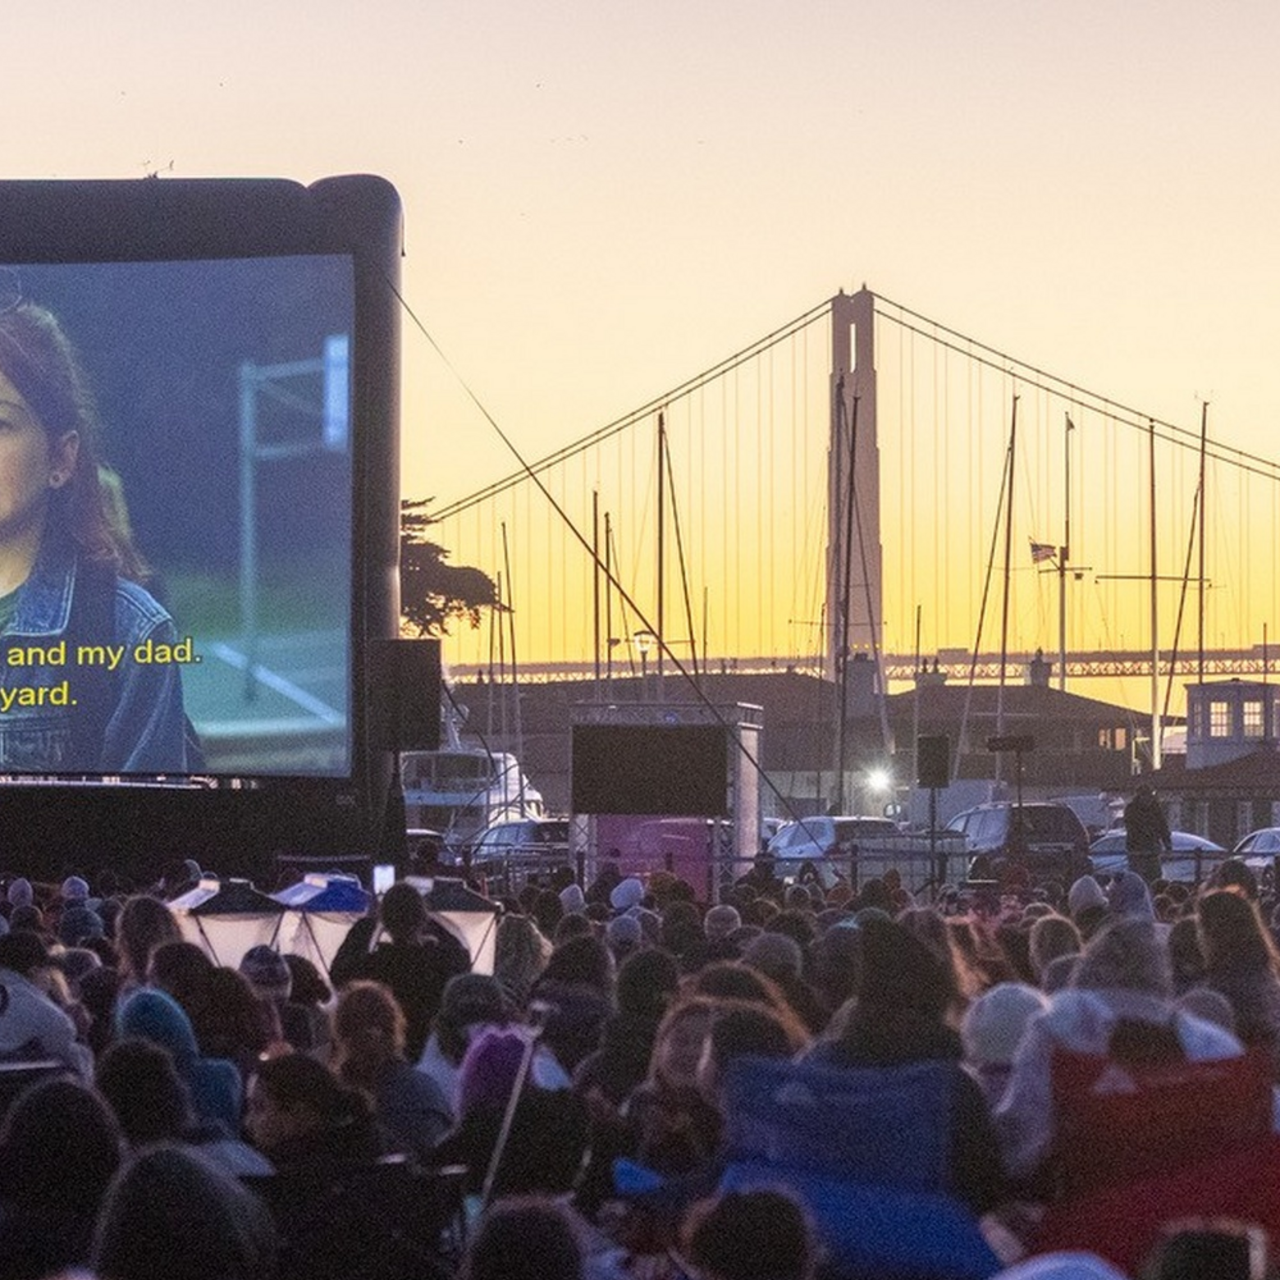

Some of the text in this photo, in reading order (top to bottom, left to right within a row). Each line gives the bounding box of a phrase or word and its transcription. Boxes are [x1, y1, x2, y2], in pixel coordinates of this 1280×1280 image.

[6, 641, 67, 666] and
[76, 645, 124, 671] my
[133, 638, 201, 664] dad.
